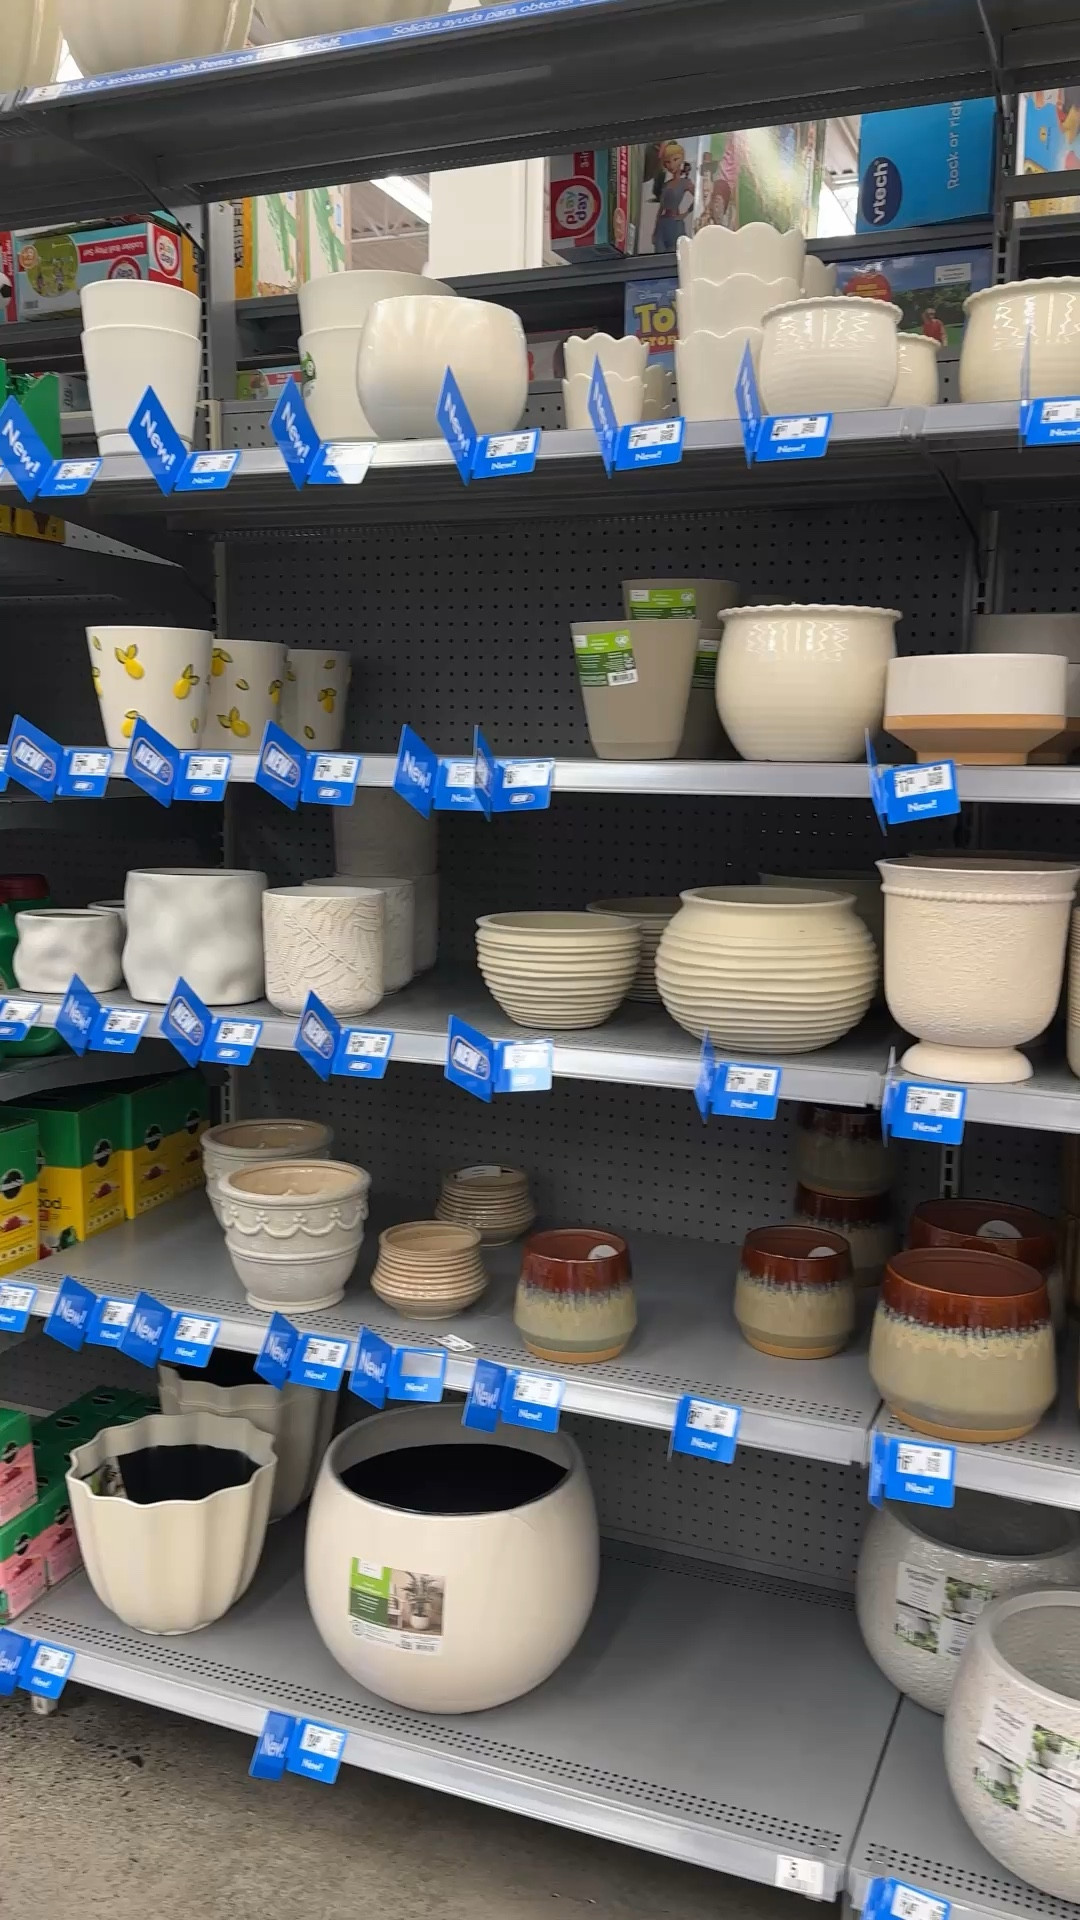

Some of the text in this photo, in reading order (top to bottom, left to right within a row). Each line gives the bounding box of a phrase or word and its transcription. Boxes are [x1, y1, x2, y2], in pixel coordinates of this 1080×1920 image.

[391, 21, 440, 36] Solicita
[442, 13, 484, 29] ayuda
[485, 8, 517, 22] para
[950, 132, 960, 148] or
[947, 151, 959, 190] Rock
[564, 190, 578, 225] play
[575, 191, 589, 221] day
[873, 161, 889, 224] vtech
[632, 301, 677, 334] TO
[280, 401, 310, 464] New!
[444, 392, 470, 458] New!
[1, 419, 41, 479] New!
[140, 410, 176, 471] New!
[634, 450, 662, 461] New!
[776, 444, 806, 454] New!
[491, 460, 518, 471] New!
[404, 750, 433, 794] New!
[730, 1098, 758, 1110] New!
[912, 1121, 942, 1134] New!
[57, 1296, 88, 1330] New!
[130, 1311, 163, 1346] New!
[266, 1332, 293, 1369] New!
[303, 1368, 328, 1381] New!
[359, 1349, 387, 1385] New!
[404, 1381, 429, 1394] New!
[471, 1380, 499, 1411] New!
[517, 1408, 543, 1422] New!
[690, 1436, 718, 1452] New!
[904, 1480, 935, 1496] New!
[262, 1731, 289, 1759] New!
[301, 1757, 325, 1773] New!
